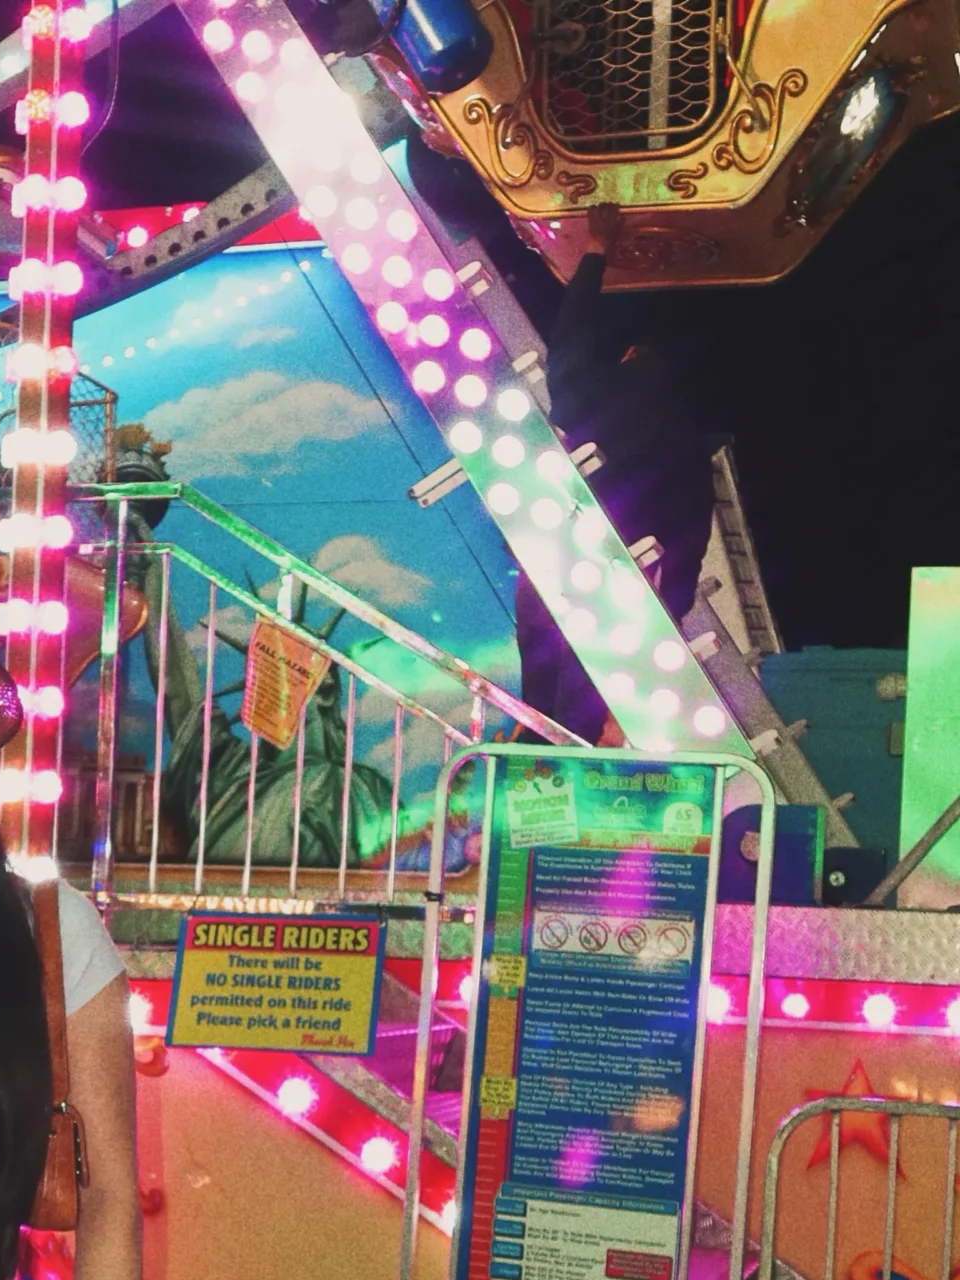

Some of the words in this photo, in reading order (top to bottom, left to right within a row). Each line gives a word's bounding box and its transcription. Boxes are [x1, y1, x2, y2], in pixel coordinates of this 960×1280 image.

[255, 641, 277, 659] FALL
[193, 922, 276, 948] SINGLE
[282, 924, 370, 952] RIDERS
[228, 954, 268, 969] There
[273, 955, 300, 970] will
[304, 956, 322, 971] be
[205, 972, 227, 986] NO
[232, 974, 282, 989] SINGLE
[287, 976, 341, 991] RIDERS
[190, 993, 263, 1011] permitted
[267, 997, 286, 1010] on
[291, 995, 317, 1011] this
[322, 997, 352, 1012] ride
[196, 1011, 243, 1027] Please
[247, 1014, 279, 1031] pick
[281, 1019, 291, 1030] a
[295, 1014, 342, 1032] friend
